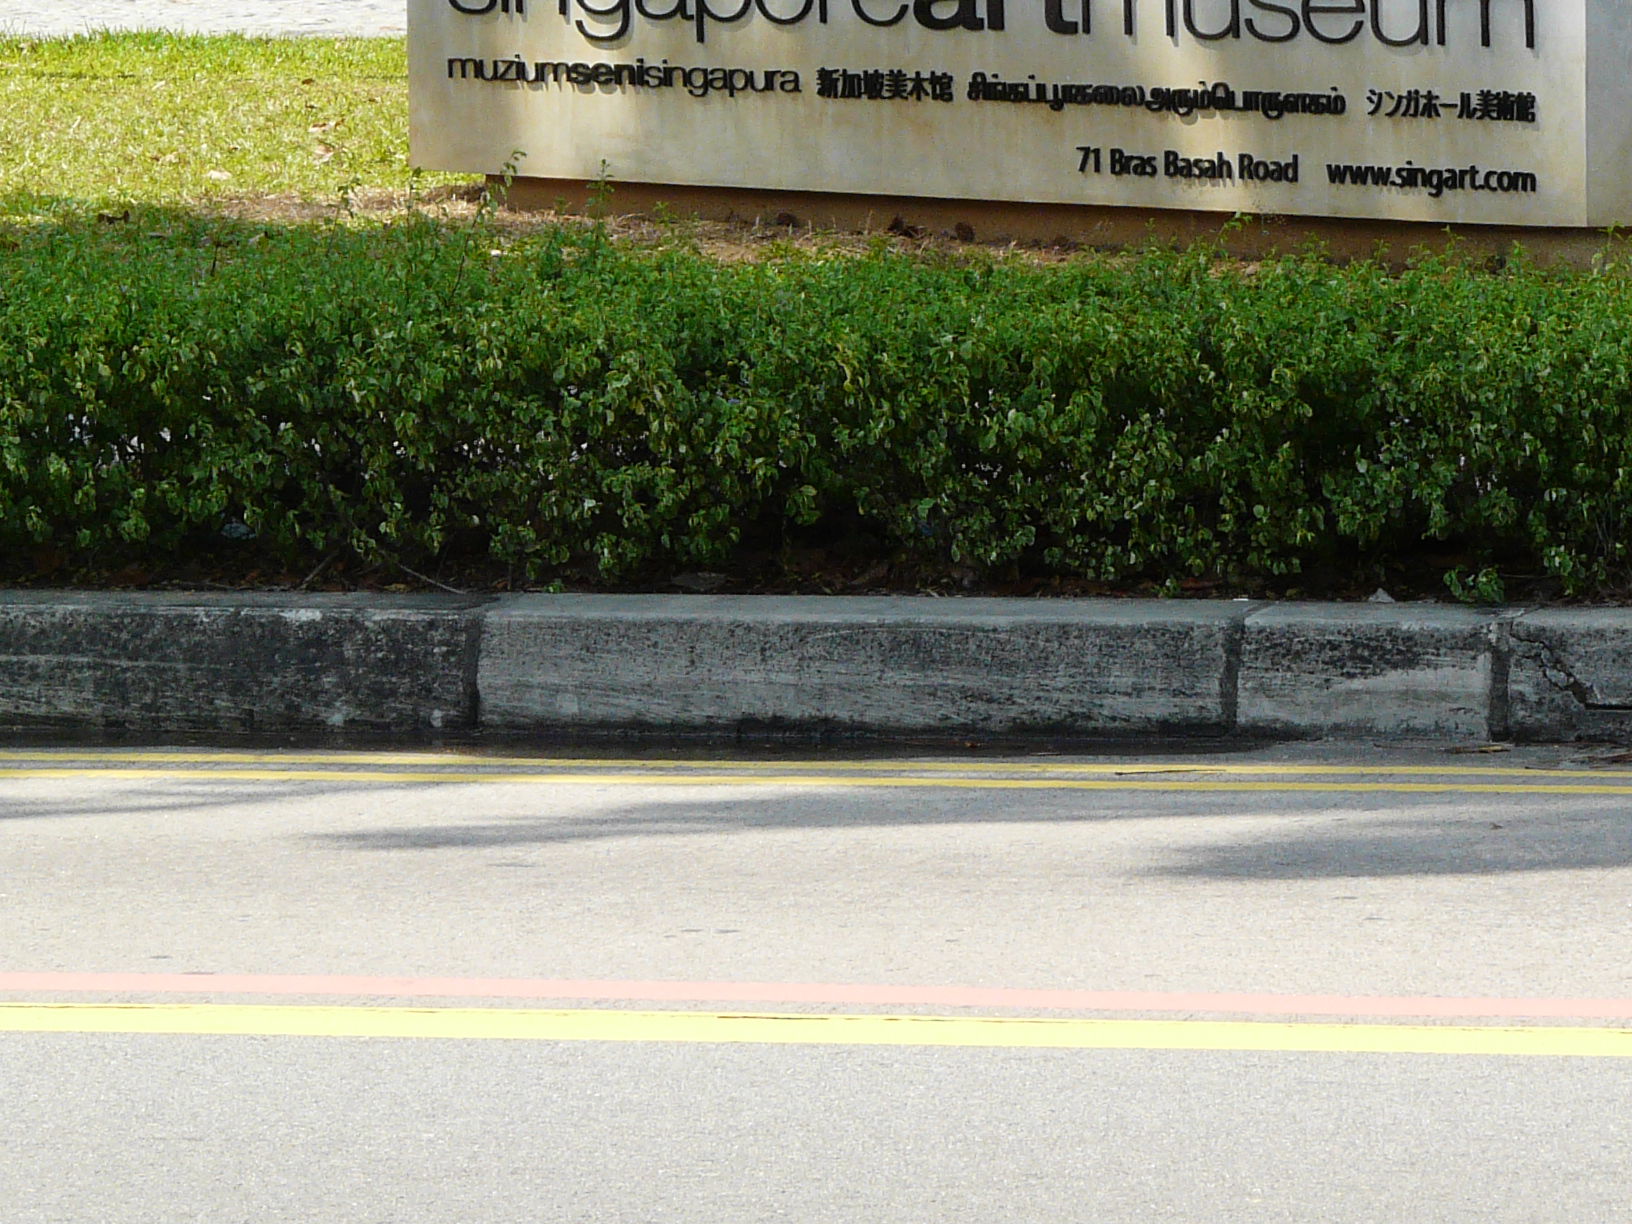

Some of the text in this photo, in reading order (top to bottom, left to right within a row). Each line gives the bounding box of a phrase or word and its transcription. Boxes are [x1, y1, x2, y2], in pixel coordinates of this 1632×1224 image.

[448, 55, 802, 97] muziumsenisingapura
[1076, 146, 1299, 183] 71 Bras Basah Road
[1326, 161, 1537, 198] www.singart.com
